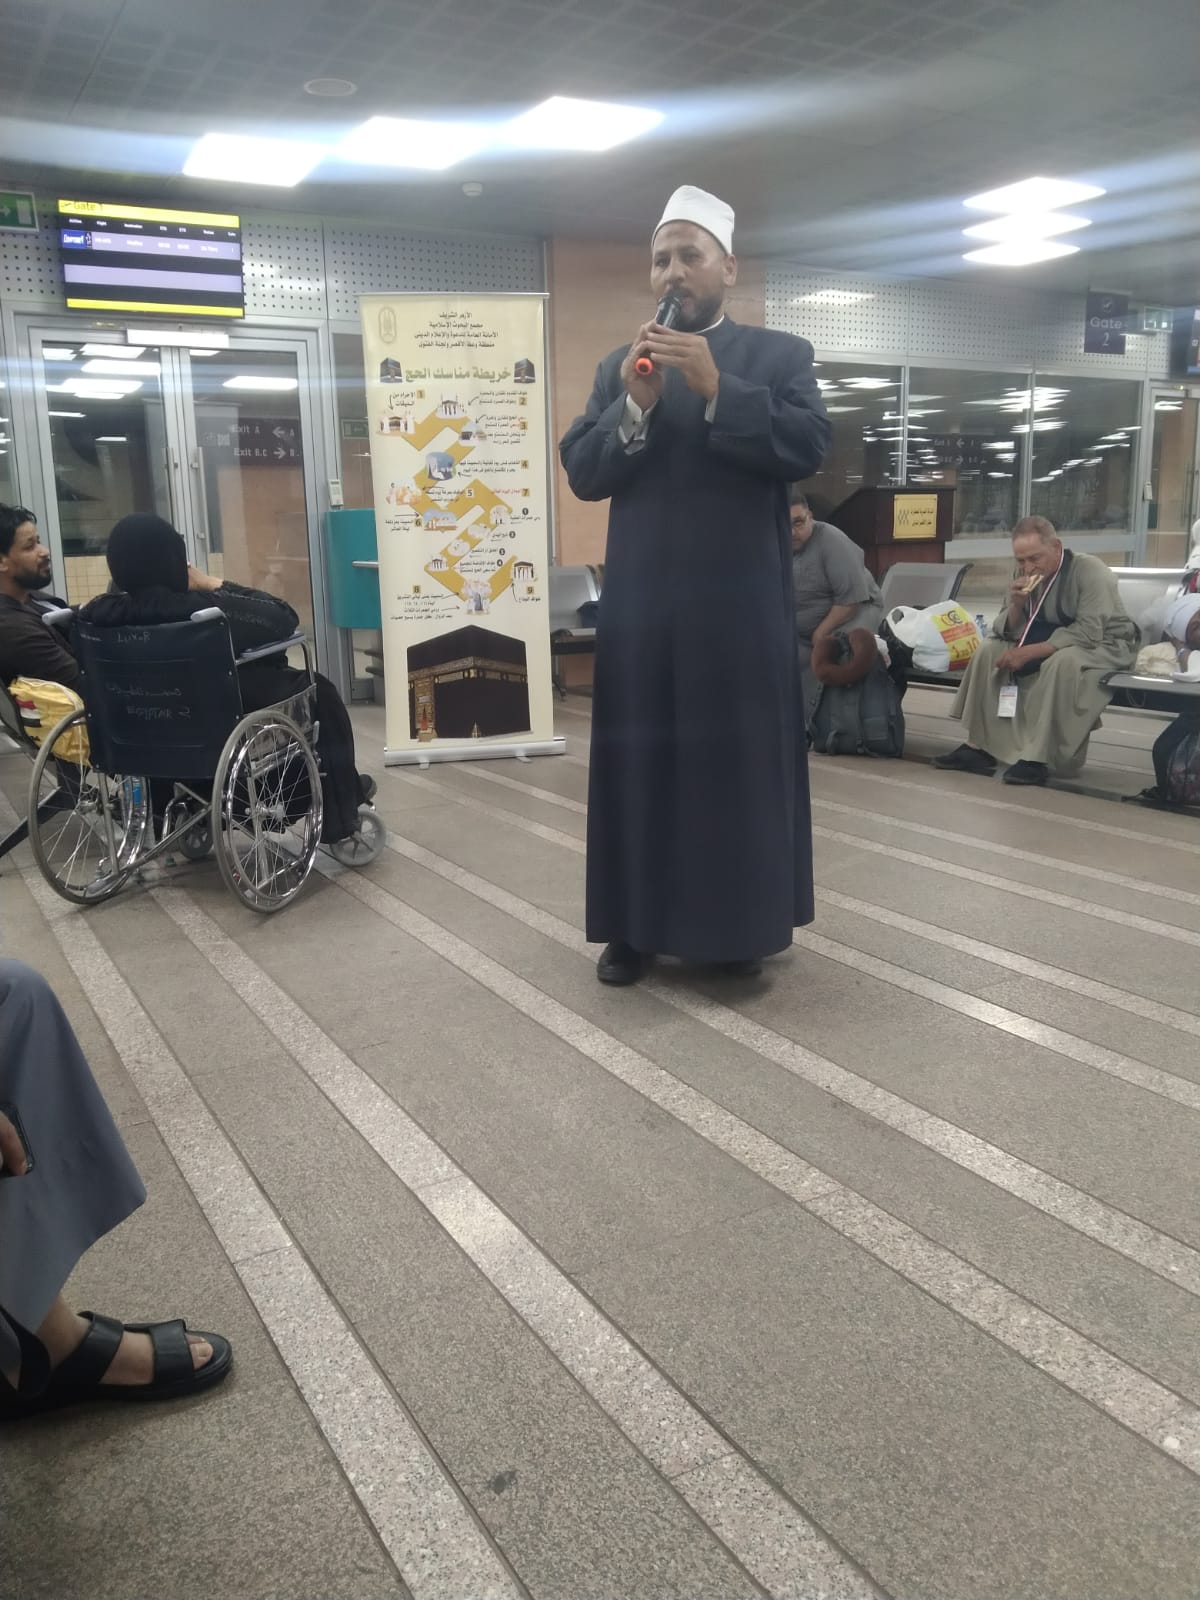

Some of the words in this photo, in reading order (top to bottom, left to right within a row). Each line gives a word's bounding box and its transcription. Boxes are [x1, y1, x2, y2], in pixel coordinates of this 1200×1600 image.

[74, 200, 96, 211] Gate
[1090, 316, 1122, 329] Gate
[1102, 332, 1110, 346] 2
[405, 368, 430, 382] الحج
[433, 366, 470, 379] مناسك
[472, 366, 511, 382] خريطة
[232, 424, 250, 433] Exit
[255, 426, 260, 434] A
[234, 448, 252, 457] Exit
